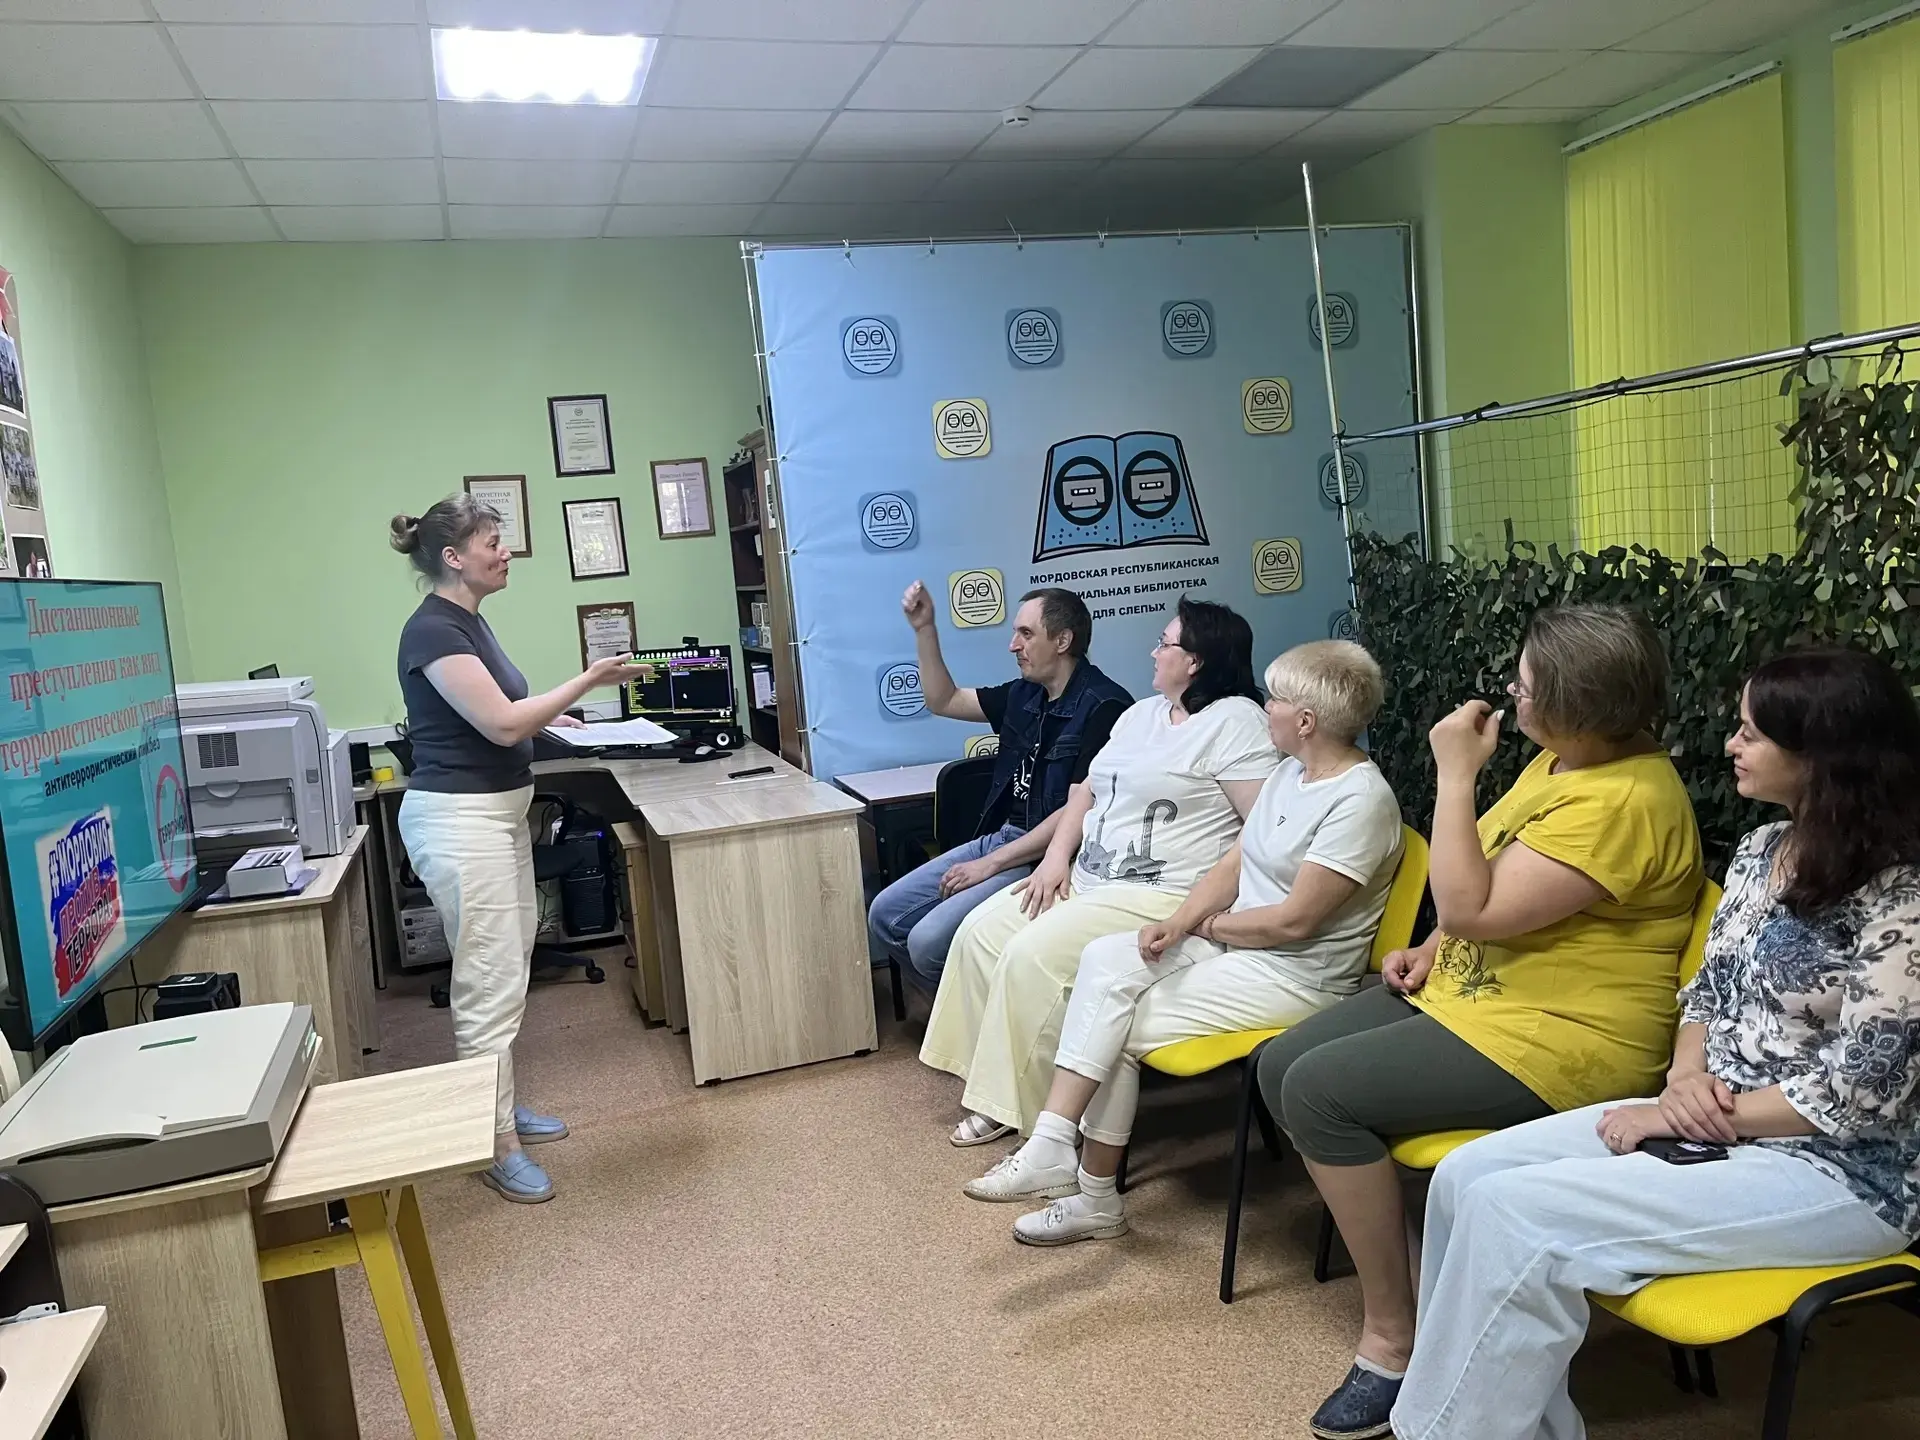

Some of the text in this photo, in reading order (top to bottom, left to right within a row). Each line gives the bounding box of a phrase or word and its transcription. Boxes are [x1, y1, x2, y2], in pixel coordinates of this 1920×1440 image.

[1030, 556, 1219, 584] МОРДОВСКАЯ РЕСПУБЛИКАНСКАЯ
[1075, 578, 1207, 600] ИАЛЬНАЯ БИБЛИОТЕКА
[26, 598, 140, 641] Дистанционные
[1092, 602, 1166, 620] ДЛЯ СЛЕПЫХ
[9, 652, 161, 711] преступления как вид
[0, 694, 139, 776] террористической
[44, 743, 137, 798] антитеррористический
[49, 818, 111, 898] #МОРДОВИЯ
[59, 867, 101, 948] ПРОТИВ
